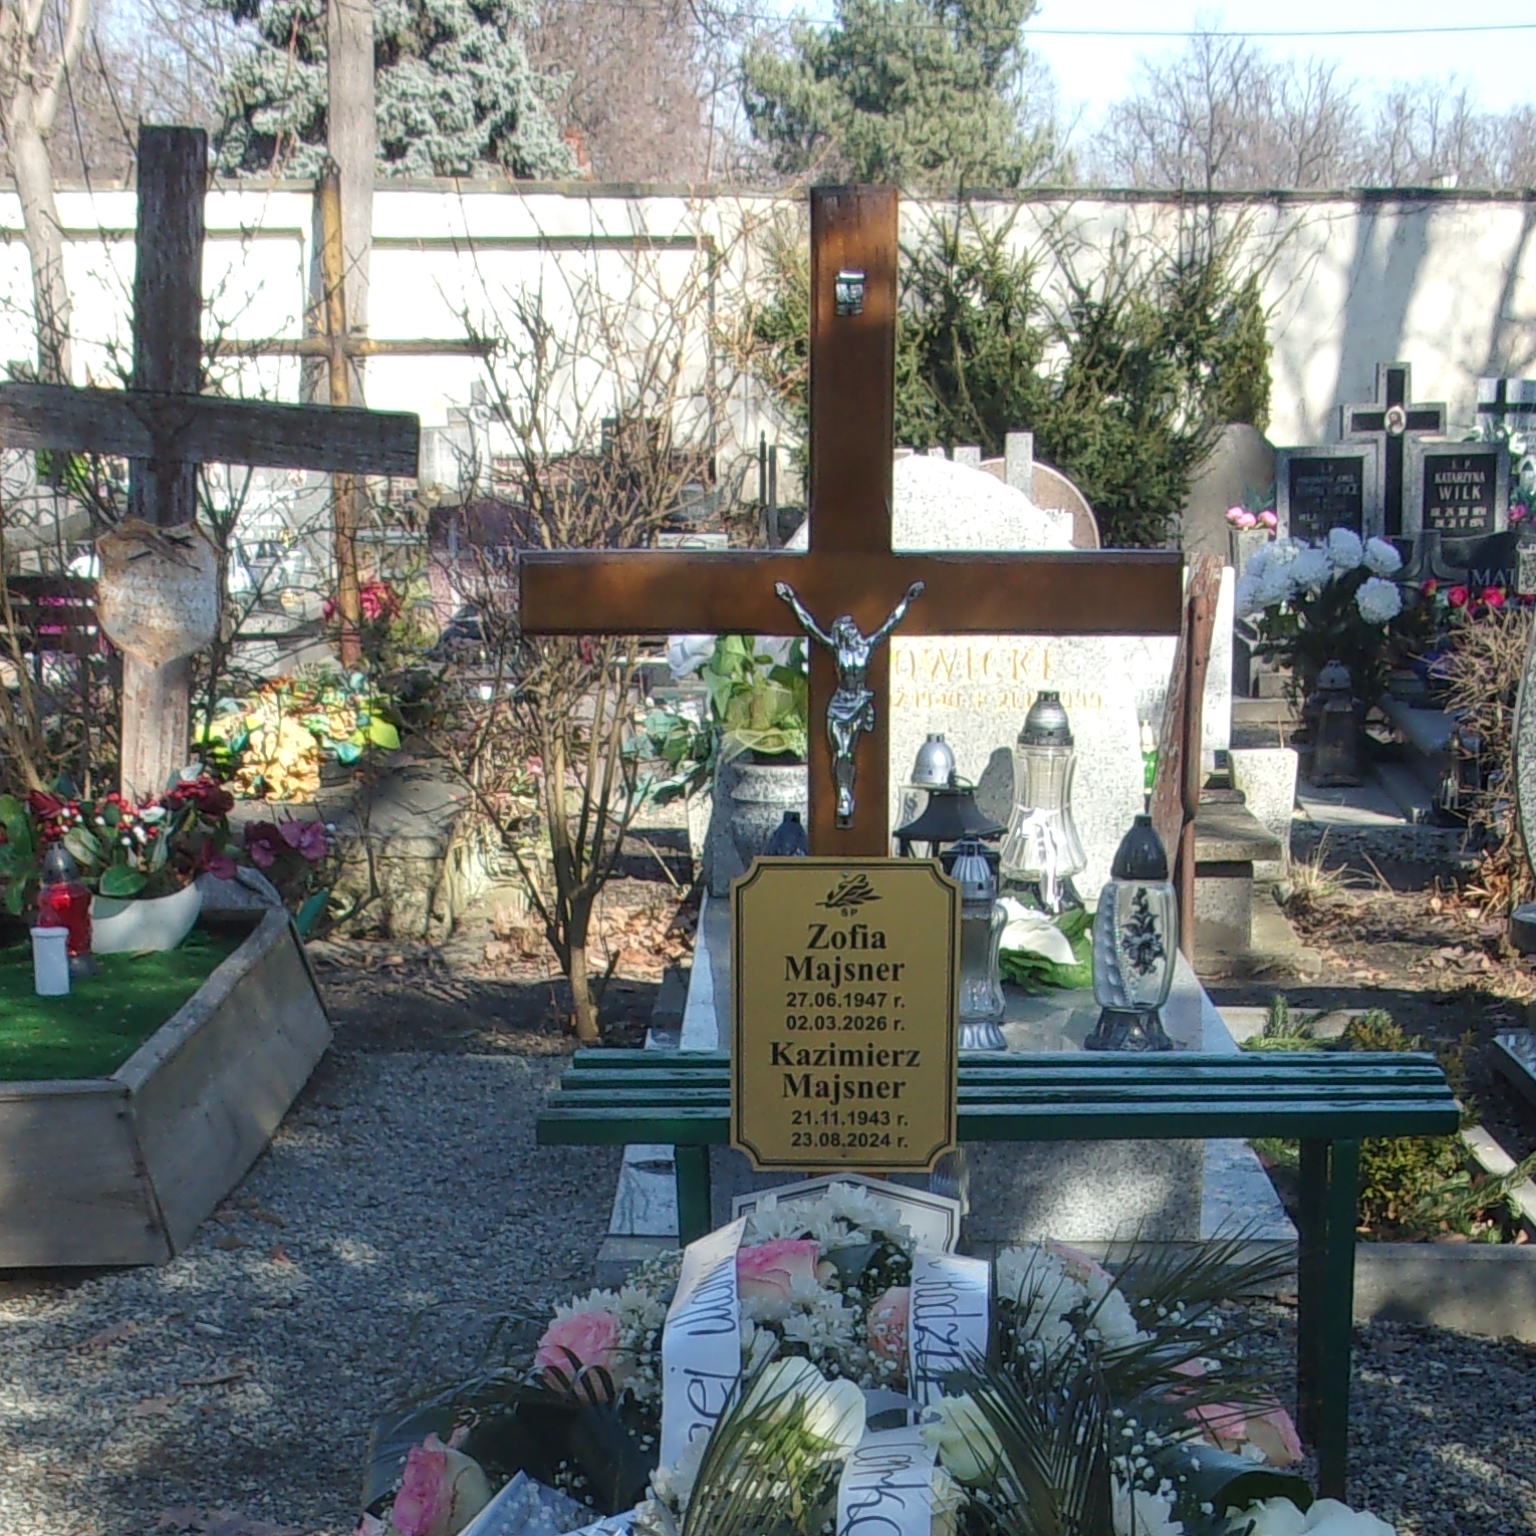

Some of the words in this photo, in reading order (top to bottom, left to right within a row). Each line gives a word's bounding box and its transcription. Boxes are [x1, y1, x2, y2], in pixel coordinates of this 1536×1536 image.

[1439, 485, 1481, 500] WILK
[807, 923, 886, 950] Zofia
[784, 955, 905, 988] Majsner
[786, 992, 887, 1008] 27.06.1947
[892, 996, 905, 1008] r.
[786, 1015, 887, 1031] 02.03.2026
[892, 1019, 905, 1031] r.
[769, 1042, 920, 1067] Kazimierz
[782, 1073, 906, 1105] Majsner
[791, 1110, 891, 1126] 21.11.1943
[896, 1114, 908, 1126] r.
[791, 1132, 891, 1148] 23.08.2024
[896, 1136, 908, 1148] r.
